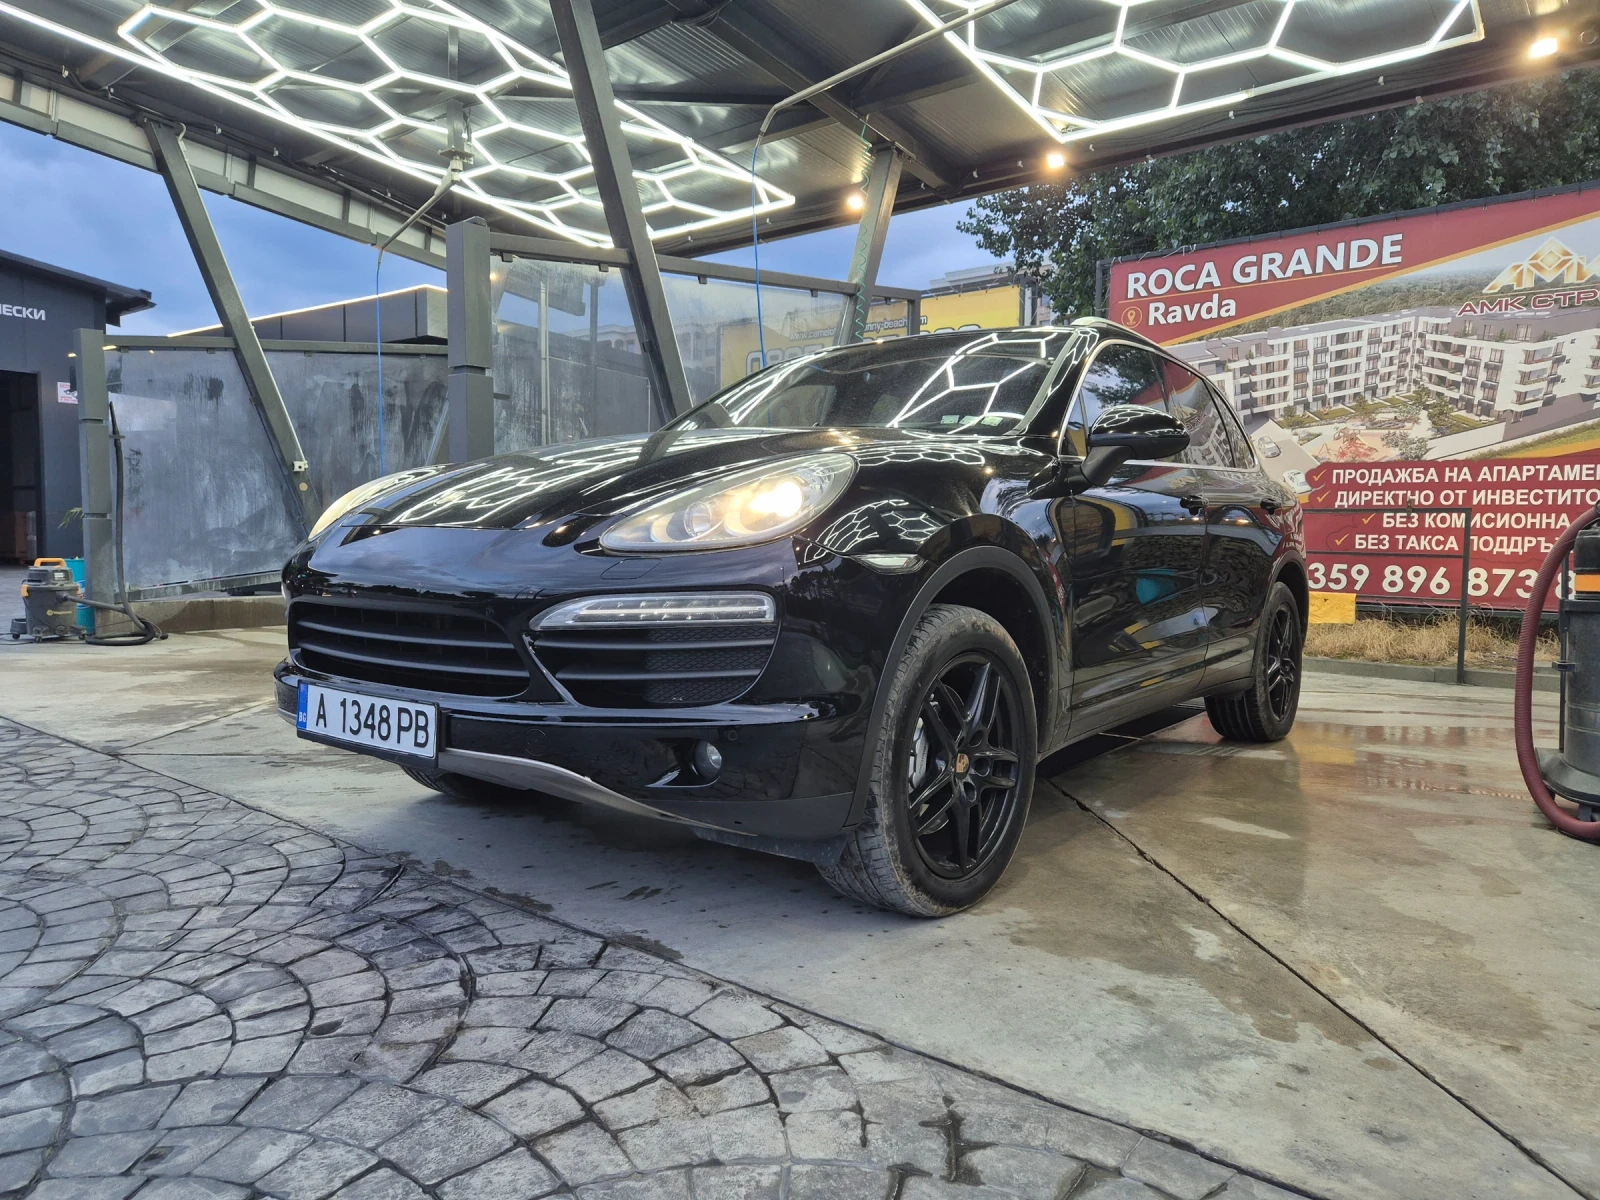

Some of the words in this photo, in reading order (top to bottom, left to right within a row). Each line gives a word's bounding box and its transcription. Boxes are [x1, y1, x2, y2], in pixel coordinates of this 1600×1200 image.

[1127, 262, 1221, 299] ROCA
[1232, 234, 1403, 284] GRANDE
[0, 303, 46, 321] ЕСКИ
[1148, 294, 1236, 326] Ravda
[1456, 296, 1527, 317] АМК
[1332, 467, 1439, 486] ПРОДАЖБА
[1444, 466, 1472, 482] НА
[1335, 490, 1434, 508] ДИРЕКТНО
[1440, 489, 1467, 505] ОТ
[1383, 512, 1418, 528] БЕЗ
[1424, 512, 1570, 529] КОМИСИОННА
[1355, 534, 1389, 549] БЕЗ
[1395, 534, 1458, 551] ТАКСА
[1308, 562, 1369, 591] 359
[1382, 565, 1450, 595] 896
[1467, 567, 1538, 599] 873
[298, 711, 307, 723] BG
[315, 692, 327, 728] A
[340, 697, 391, 741] 1348
[397, 707, 429, 748] PB
